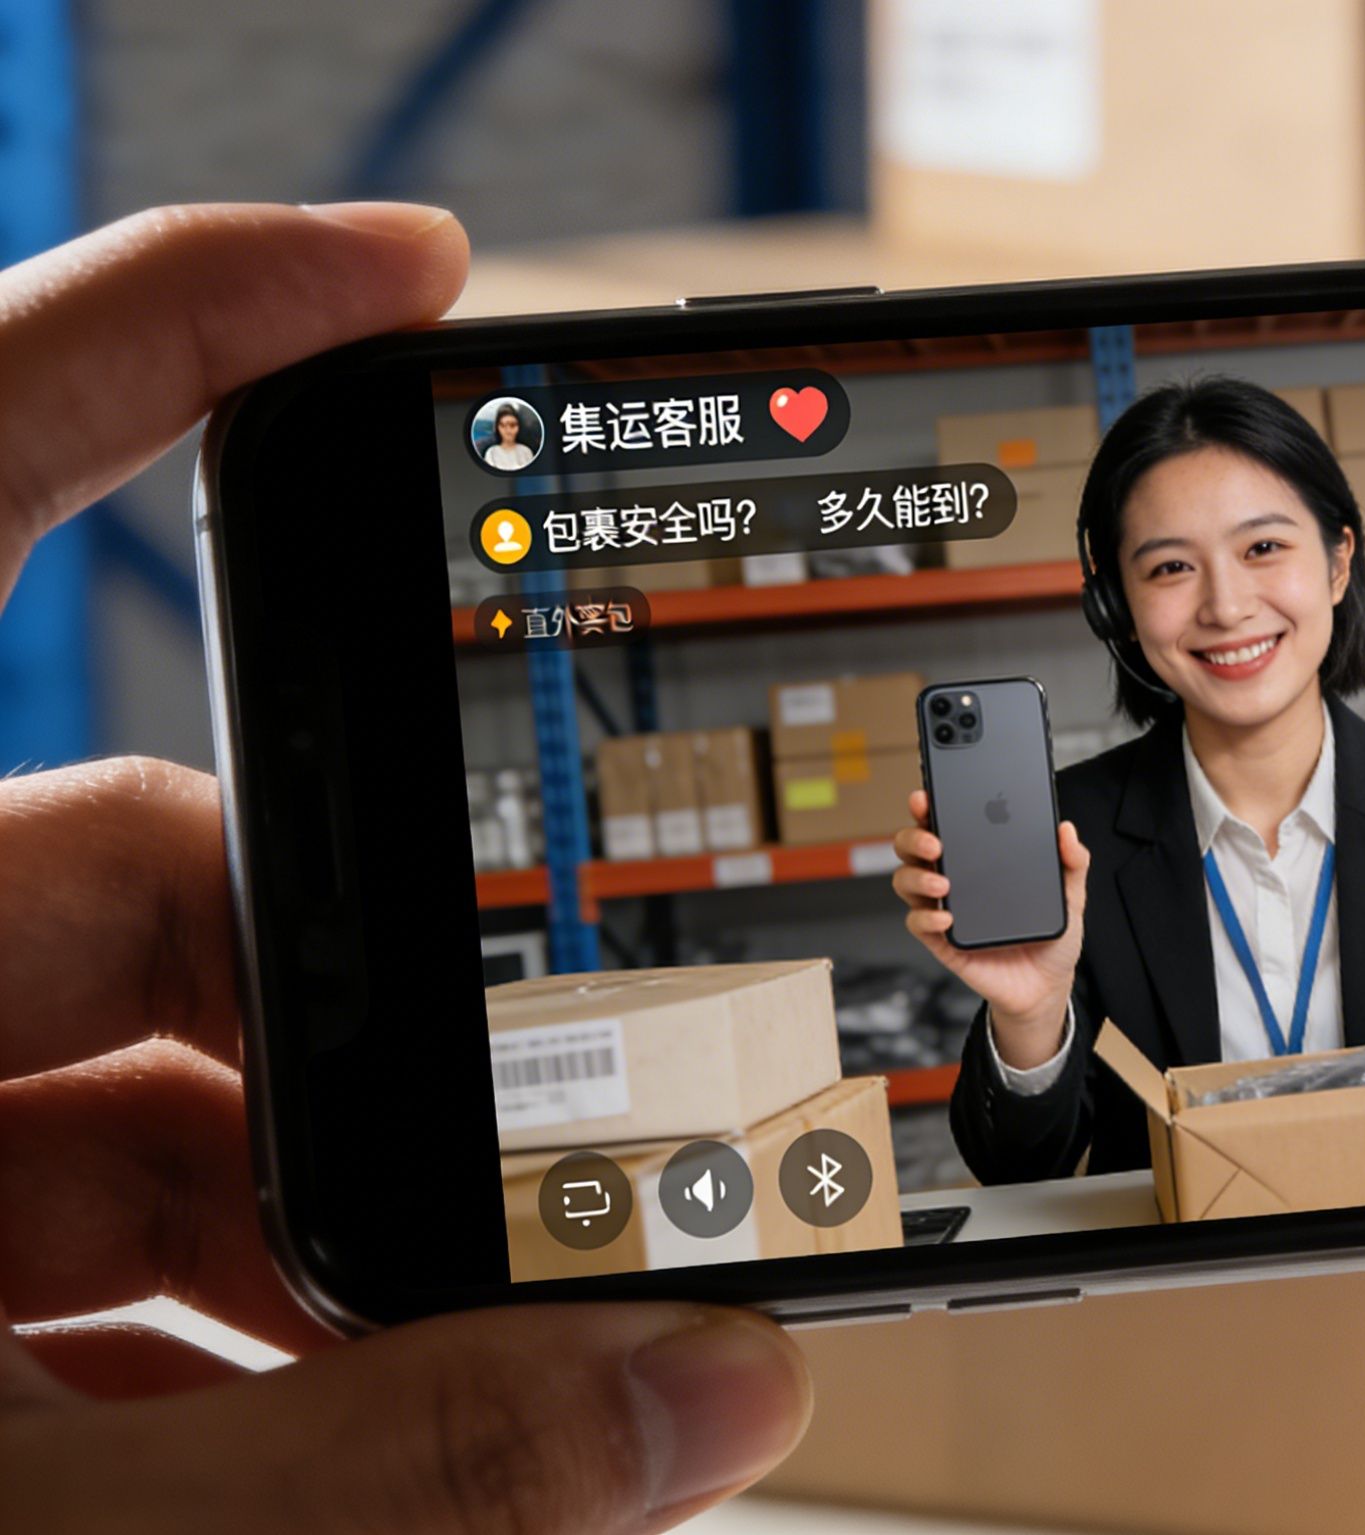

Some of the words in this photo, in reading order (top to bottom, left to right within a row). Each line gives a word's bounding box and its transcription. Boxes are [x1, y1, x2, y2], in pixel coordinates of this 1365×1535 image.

[559, 394, 745, 454] 集运客服
[542, 498, 757, 553] 包裹安全吗?
[817, 480, 990, 535] 多久能到?
